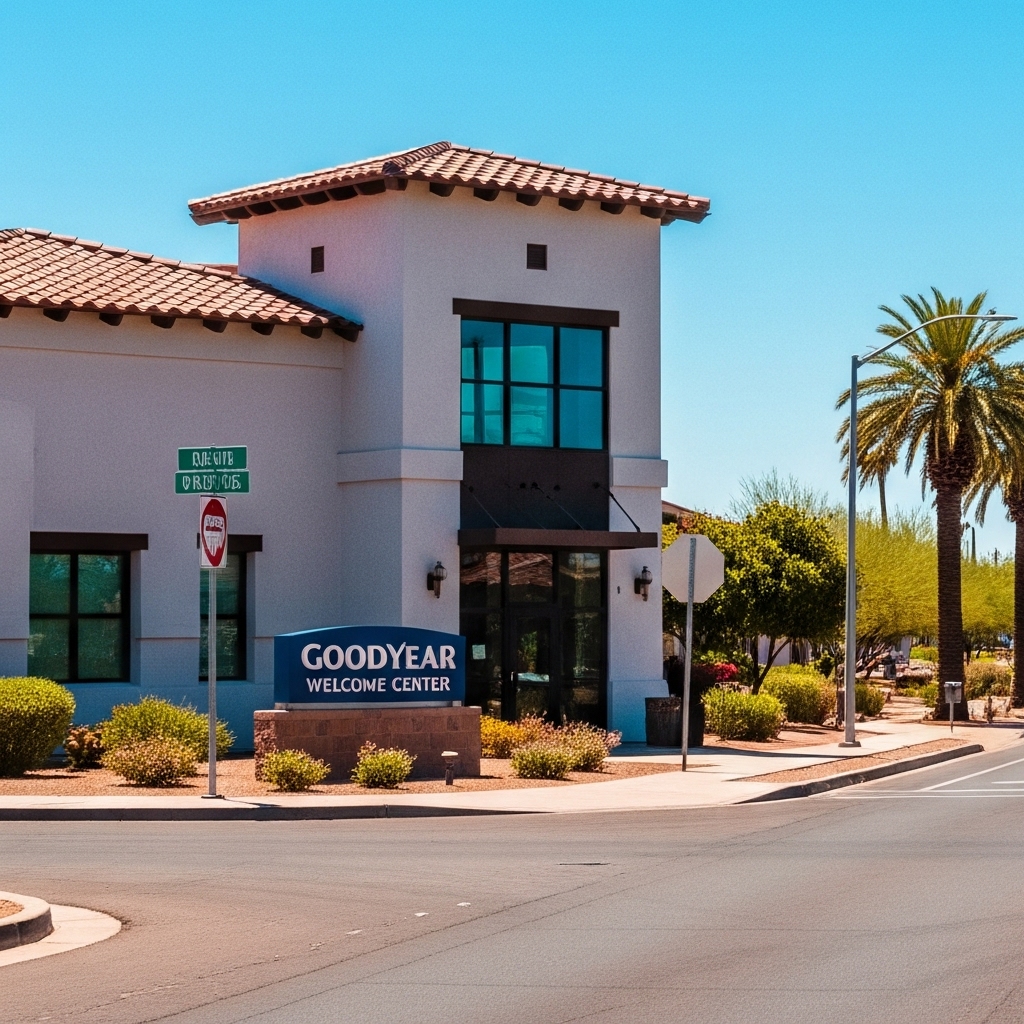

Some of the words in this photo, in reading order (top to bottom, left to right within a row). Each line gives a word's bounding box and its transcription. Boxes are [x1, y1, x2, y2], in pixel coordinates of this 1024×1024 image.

[301, 642, 456, 671] GOODYEAR
[306, 677, 387, 693] WELCOME
[391, 676, 451, 692] CENTER
